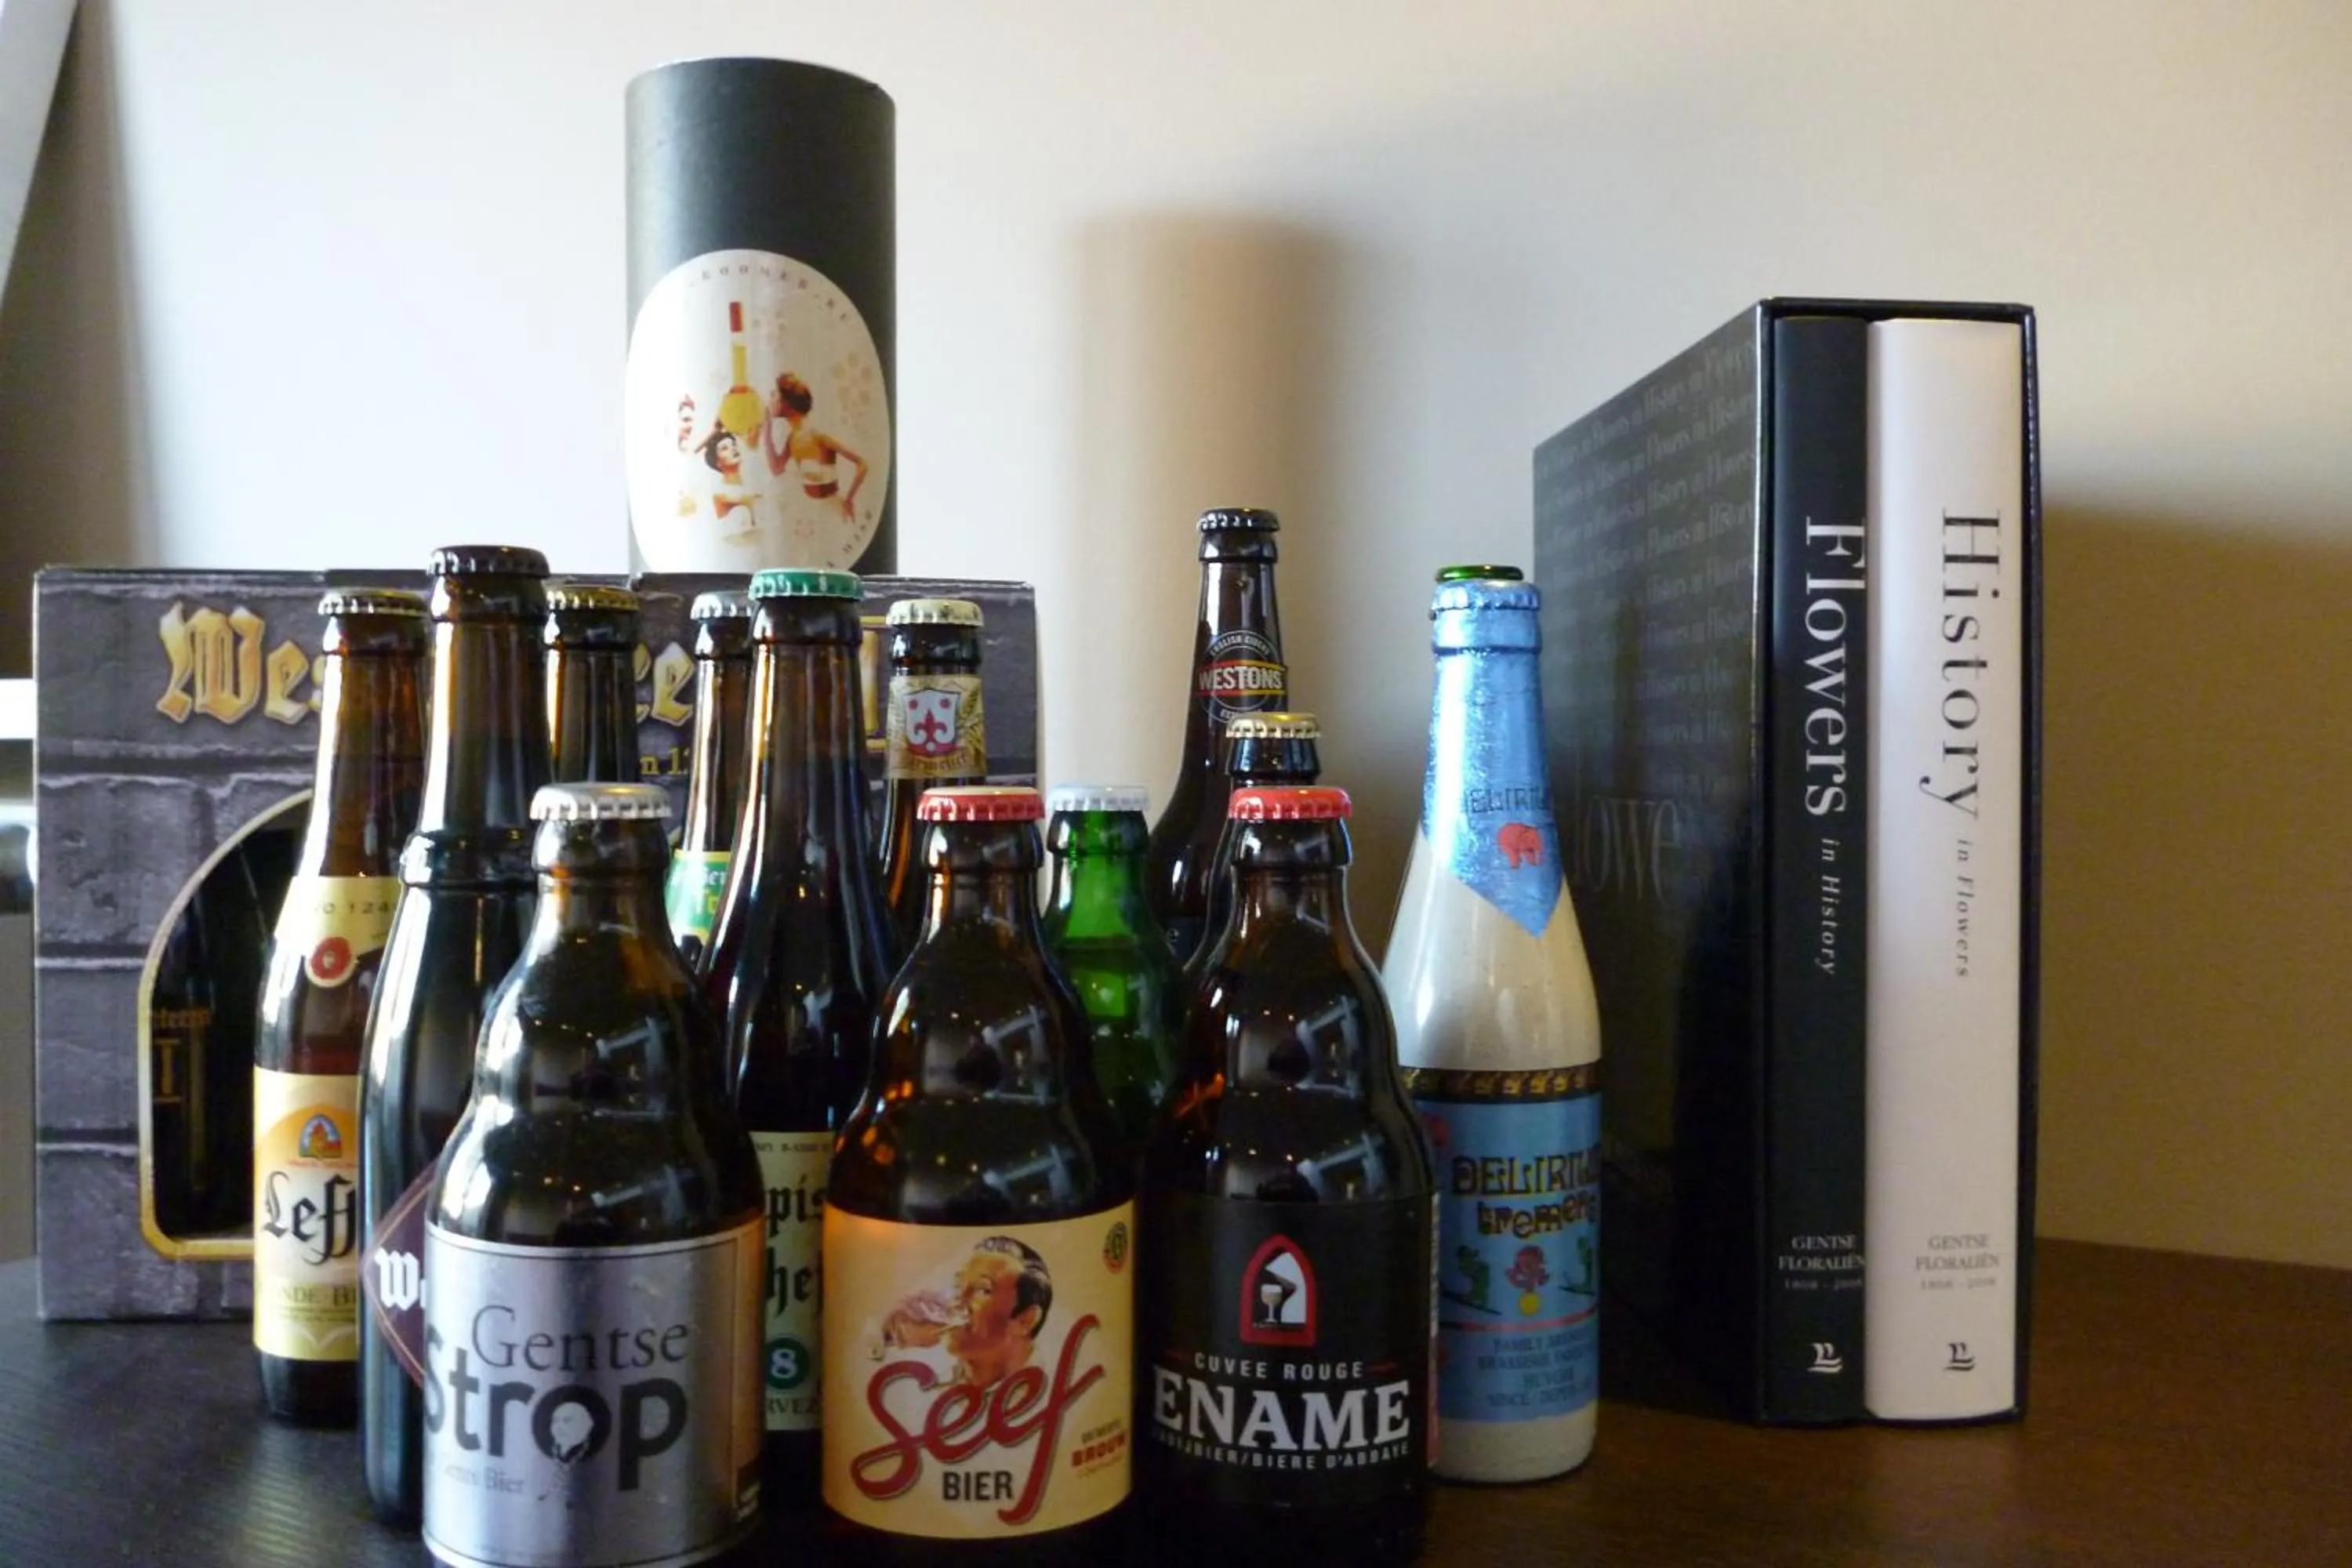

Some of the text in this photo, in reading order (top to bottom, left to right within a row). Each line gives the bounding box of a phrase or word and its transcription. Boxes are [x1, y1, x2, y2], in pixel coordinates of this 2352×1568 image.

[1198, 666, 1283, 691] WESTONS
[1805, 516, 1866, 976] Flowers in History
[1918, 508, 2002, 978] History in Flowers
[1791, 1234, 1857, 1250] GENTSE
[1928, 1233, 1990, 1251] GENTSE
[471, 1304, 689, 1373] Gentse
[771, 1348, 798, 1380] 8
[1193, 1352, 1365, 1381] CUVEE ROUGE
[850, 1312, 1106, 1527] Seef
[1152, 1364, 1411, 1452] ENAME
[942, 1470, 1014, 1502] BIER
